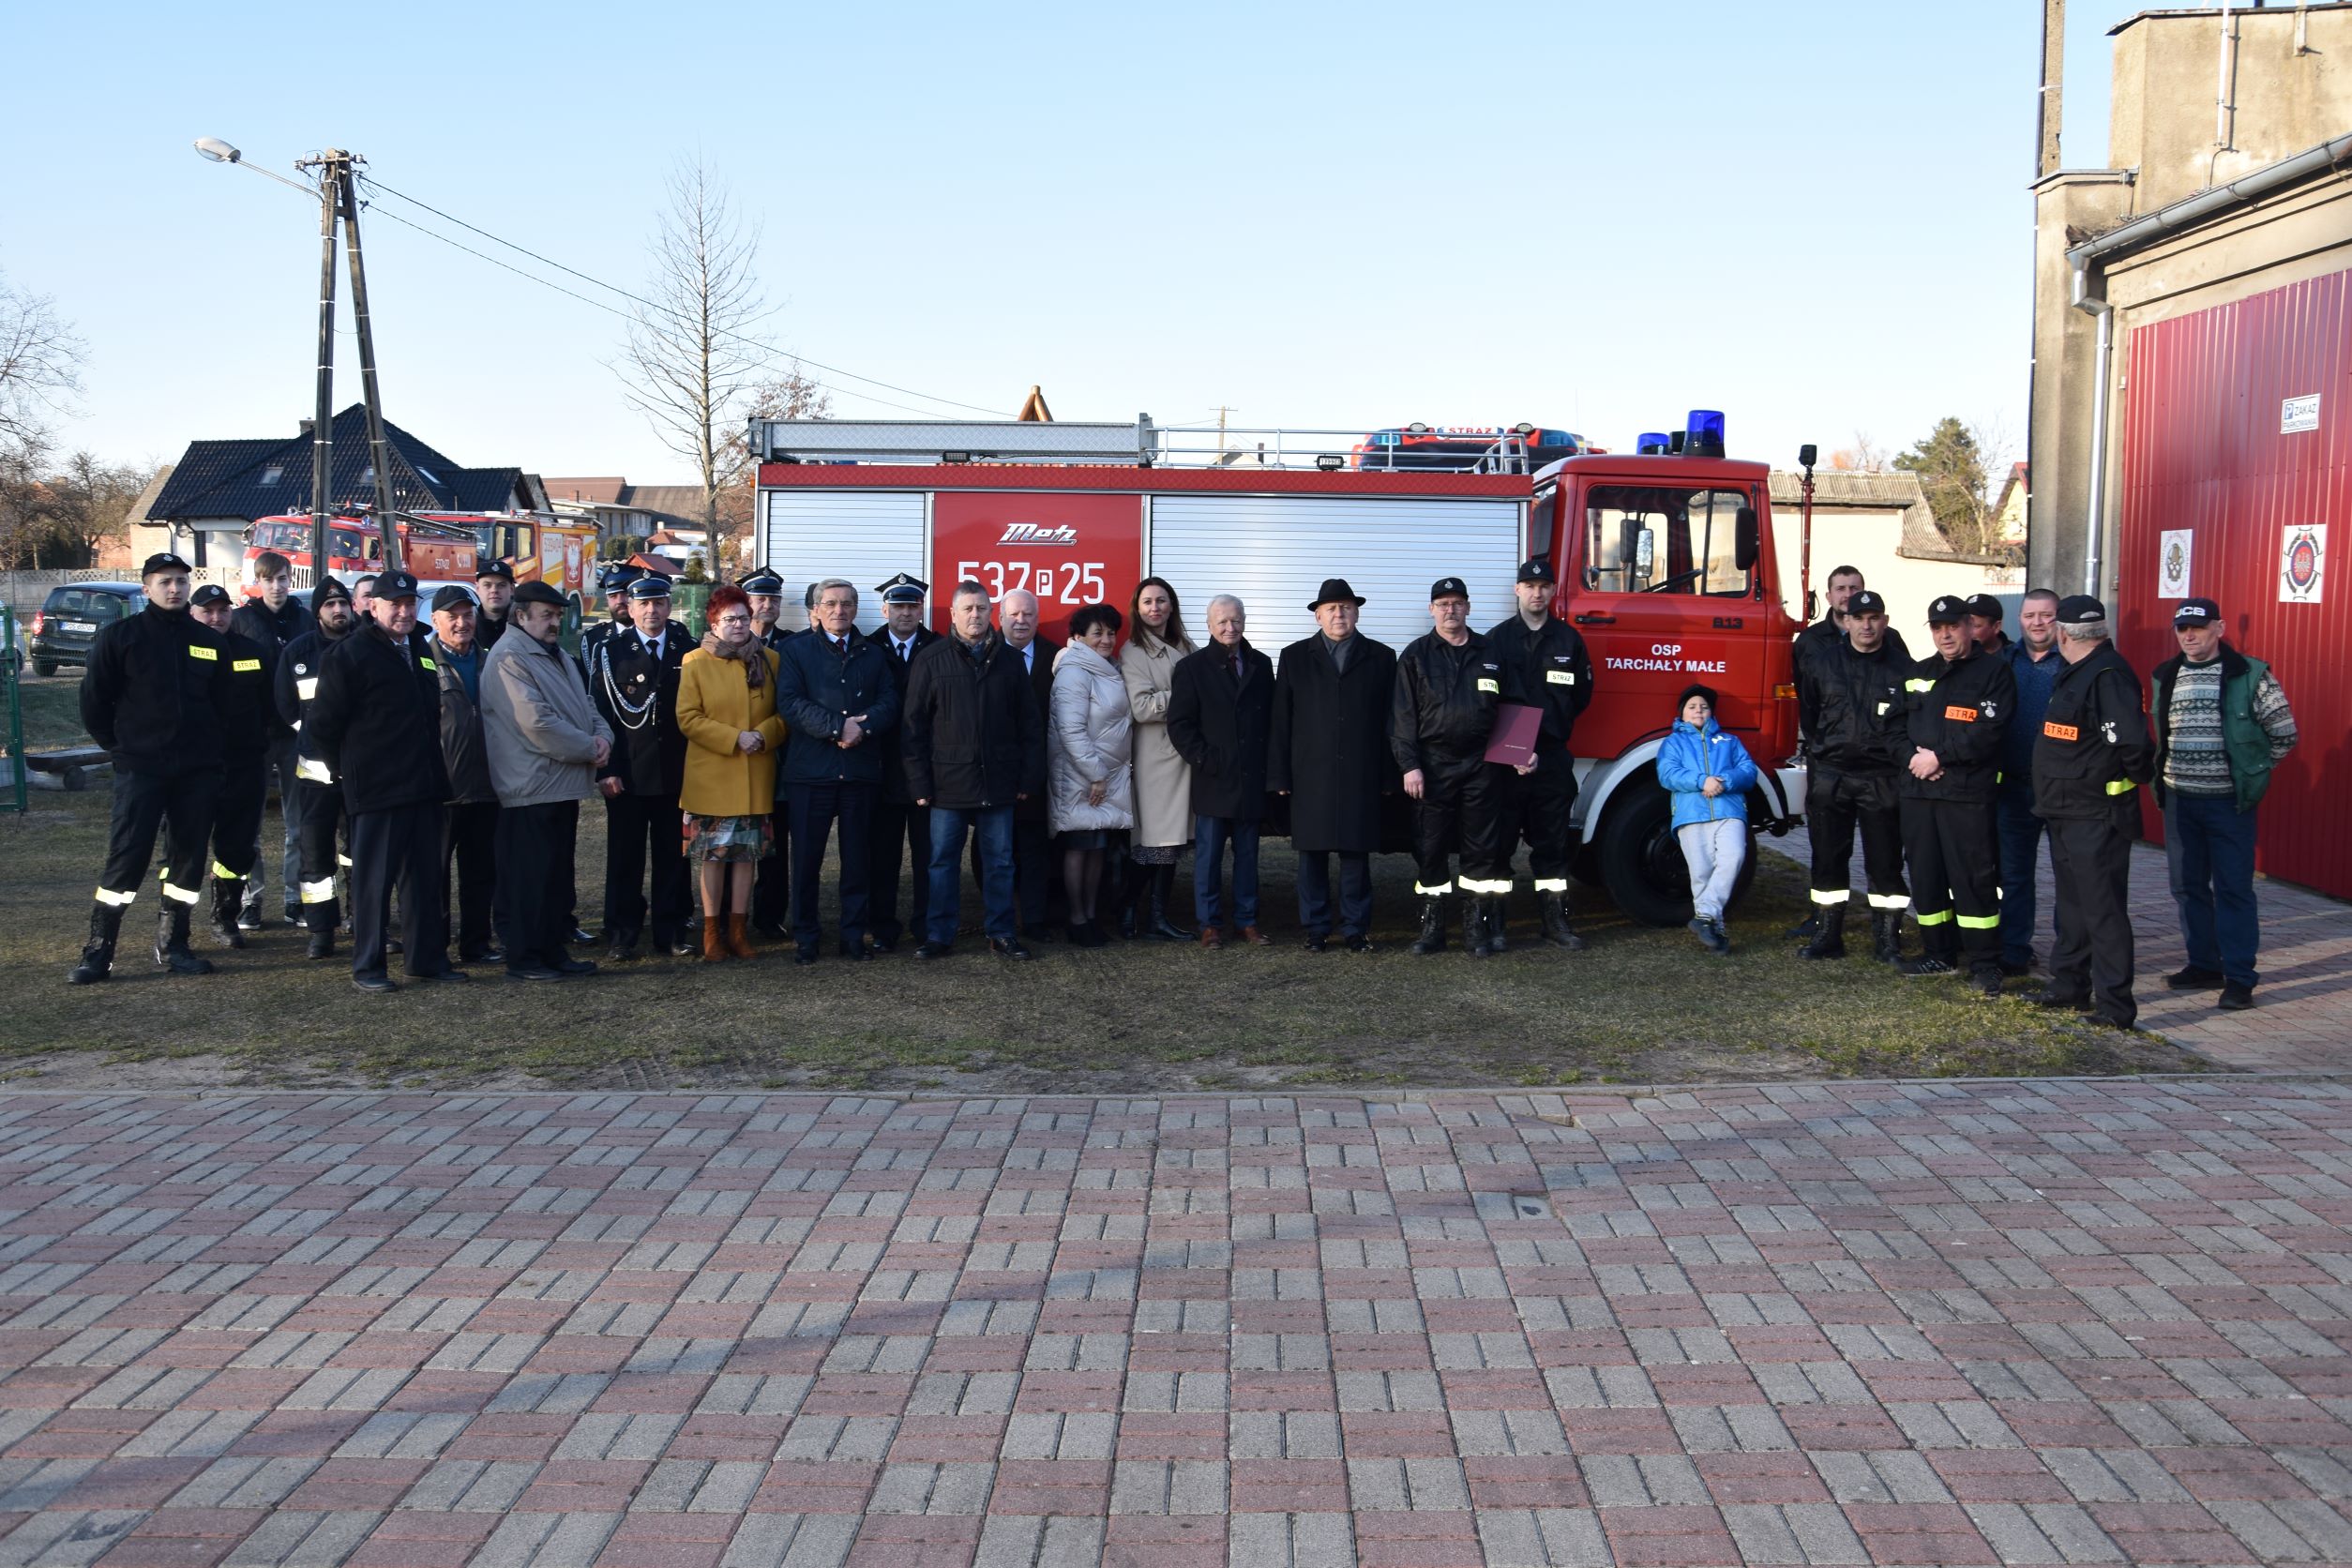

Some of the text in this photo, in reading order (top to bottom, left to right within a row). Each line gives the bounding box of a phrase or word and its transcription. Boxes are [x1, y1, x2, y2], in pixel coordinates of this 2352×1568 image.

[997, 523, 1077, 546] Metz
[1059, 563, 1105, 605] 25
[1651, 643, 1681, 656] OSP
[1606, 657, 1726, 673] TARCHAŁY MAŁE
[2101, 721, 2116, 731] OSP
